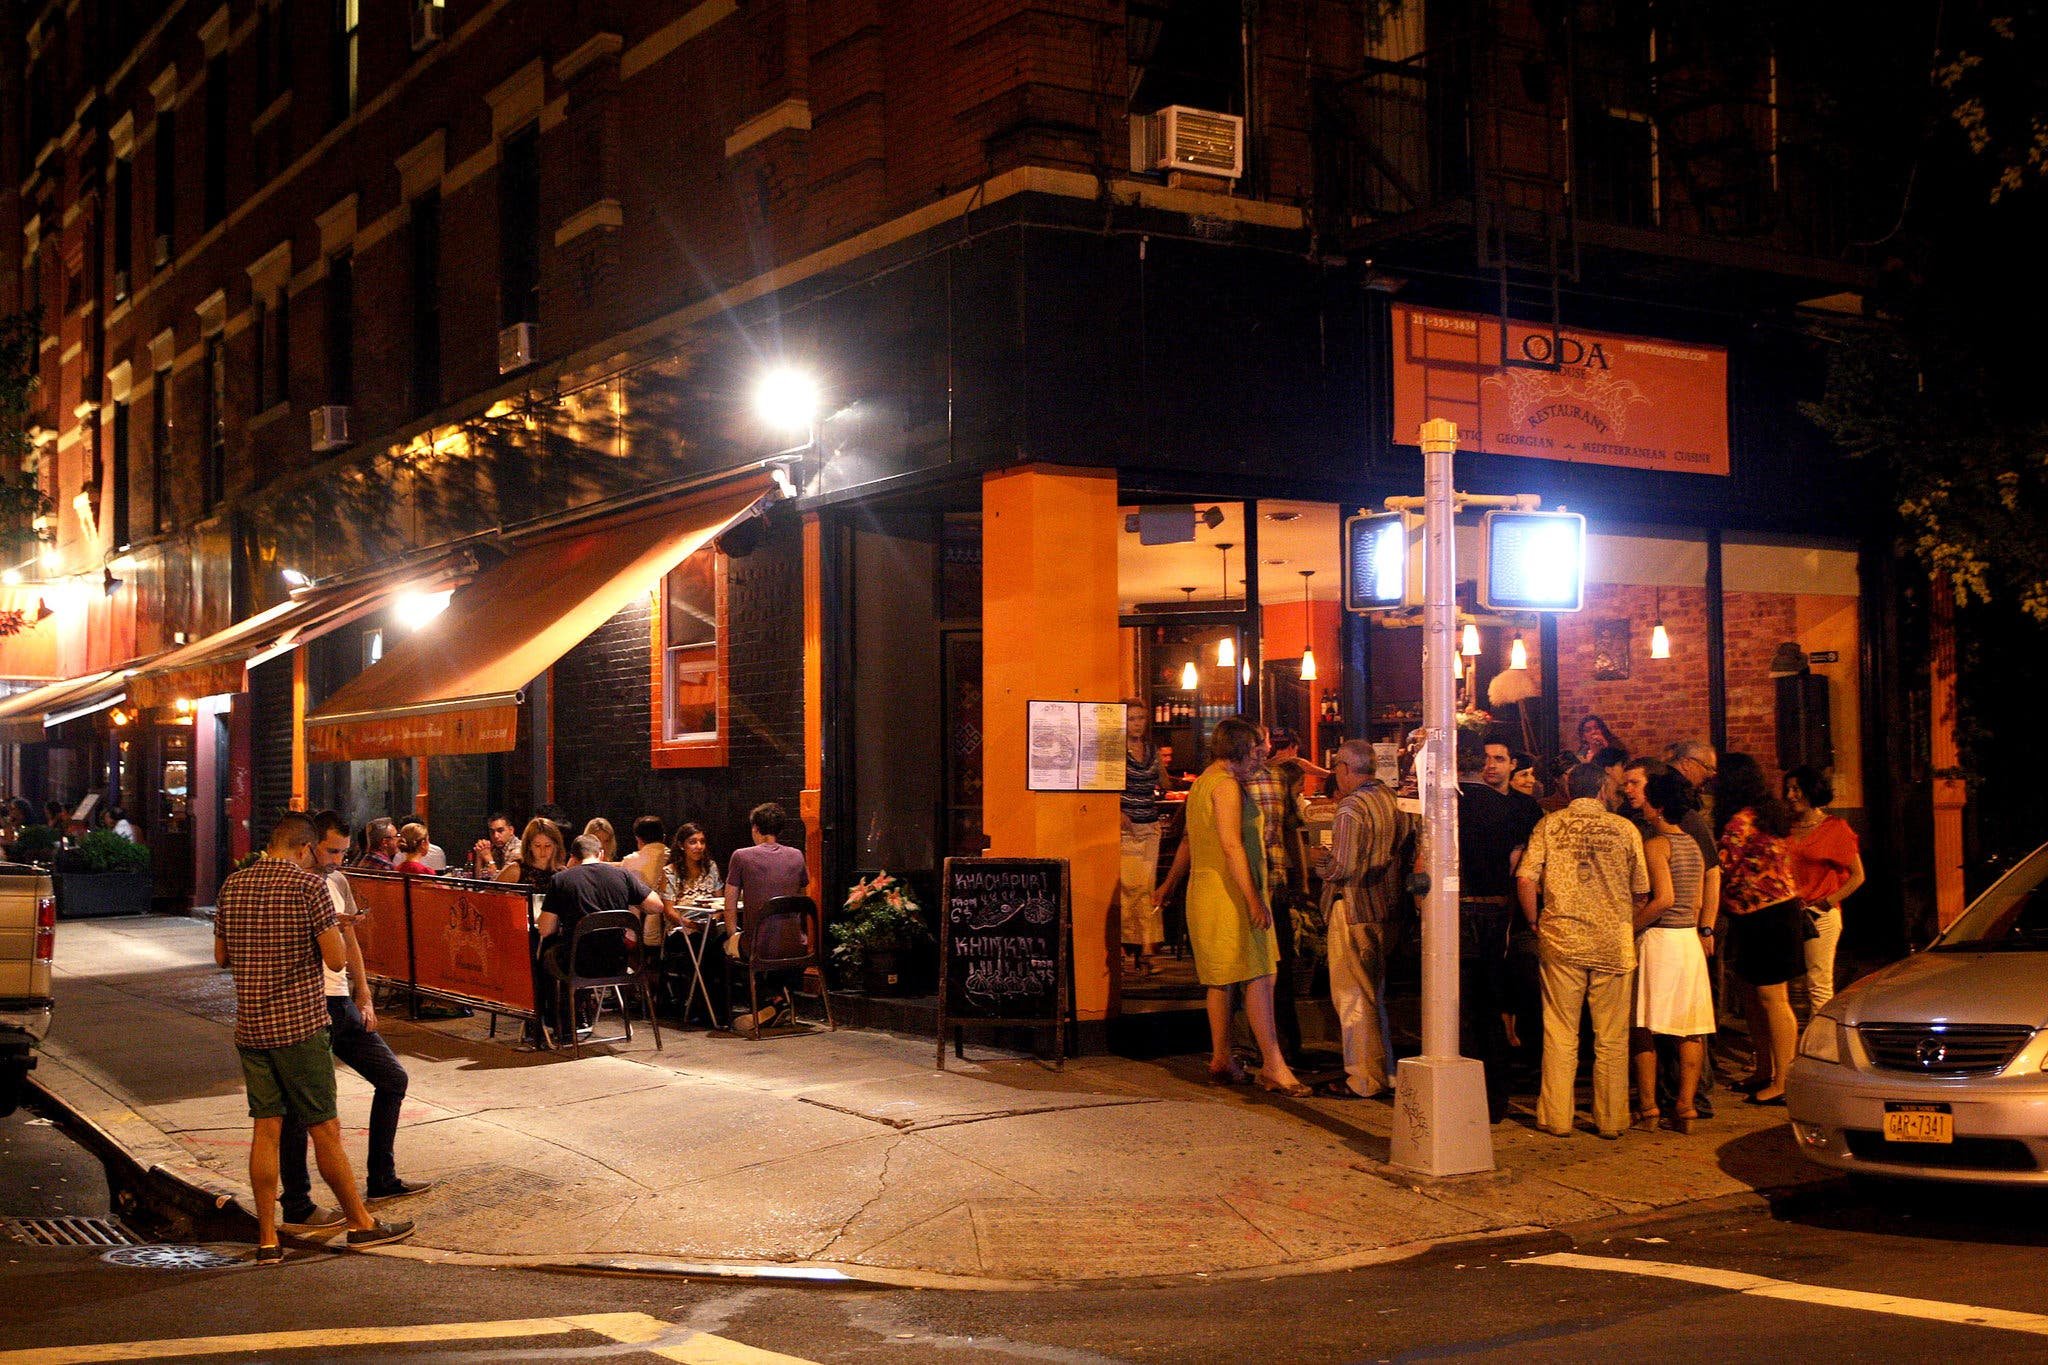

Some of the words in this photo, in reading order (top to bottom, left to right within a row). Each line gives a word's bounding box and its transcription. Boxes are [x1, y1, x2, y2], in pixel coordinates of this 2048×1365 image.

[1523, 335, 1609, 370] ODA
[1553, 366, 1587, 379] OUSE
[1528, 404, 1608, 433] RESTAURANT
[1496, 433, 1555, 449] GEORGIAN
